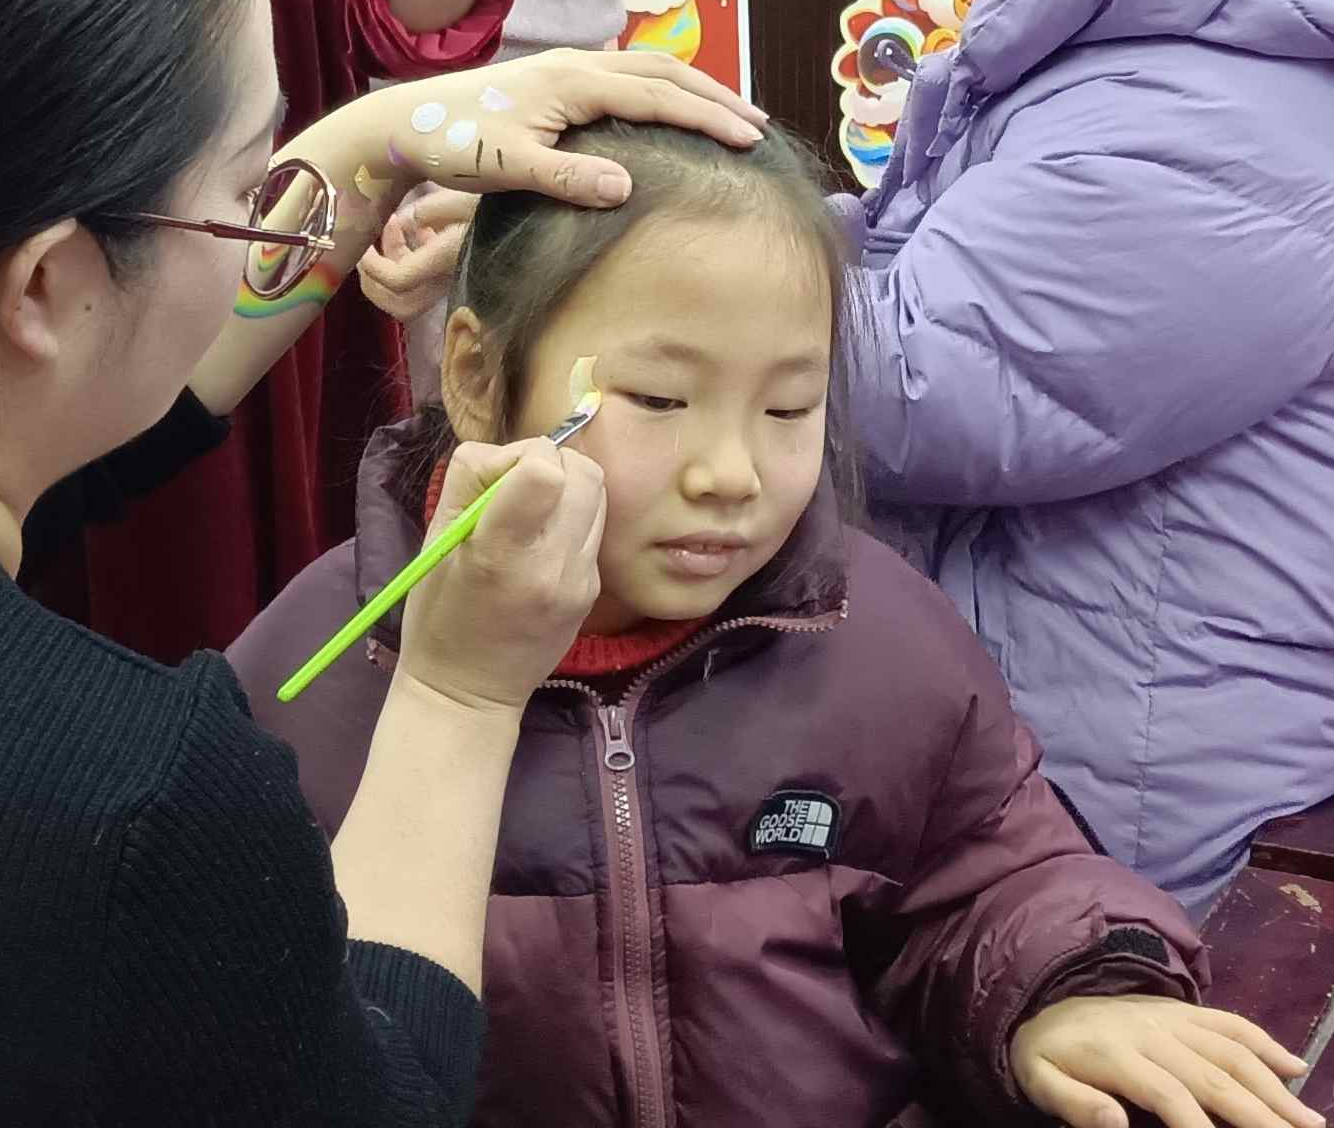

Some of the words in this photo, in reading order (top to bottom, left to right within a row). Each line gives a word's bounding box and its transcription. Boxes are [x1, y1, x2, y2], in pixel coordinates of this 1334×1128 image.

[783, 800, 811, 814] THE
[760, 814, 807, 829] GOOSE
[755, 828, 801, 844] WORLD
